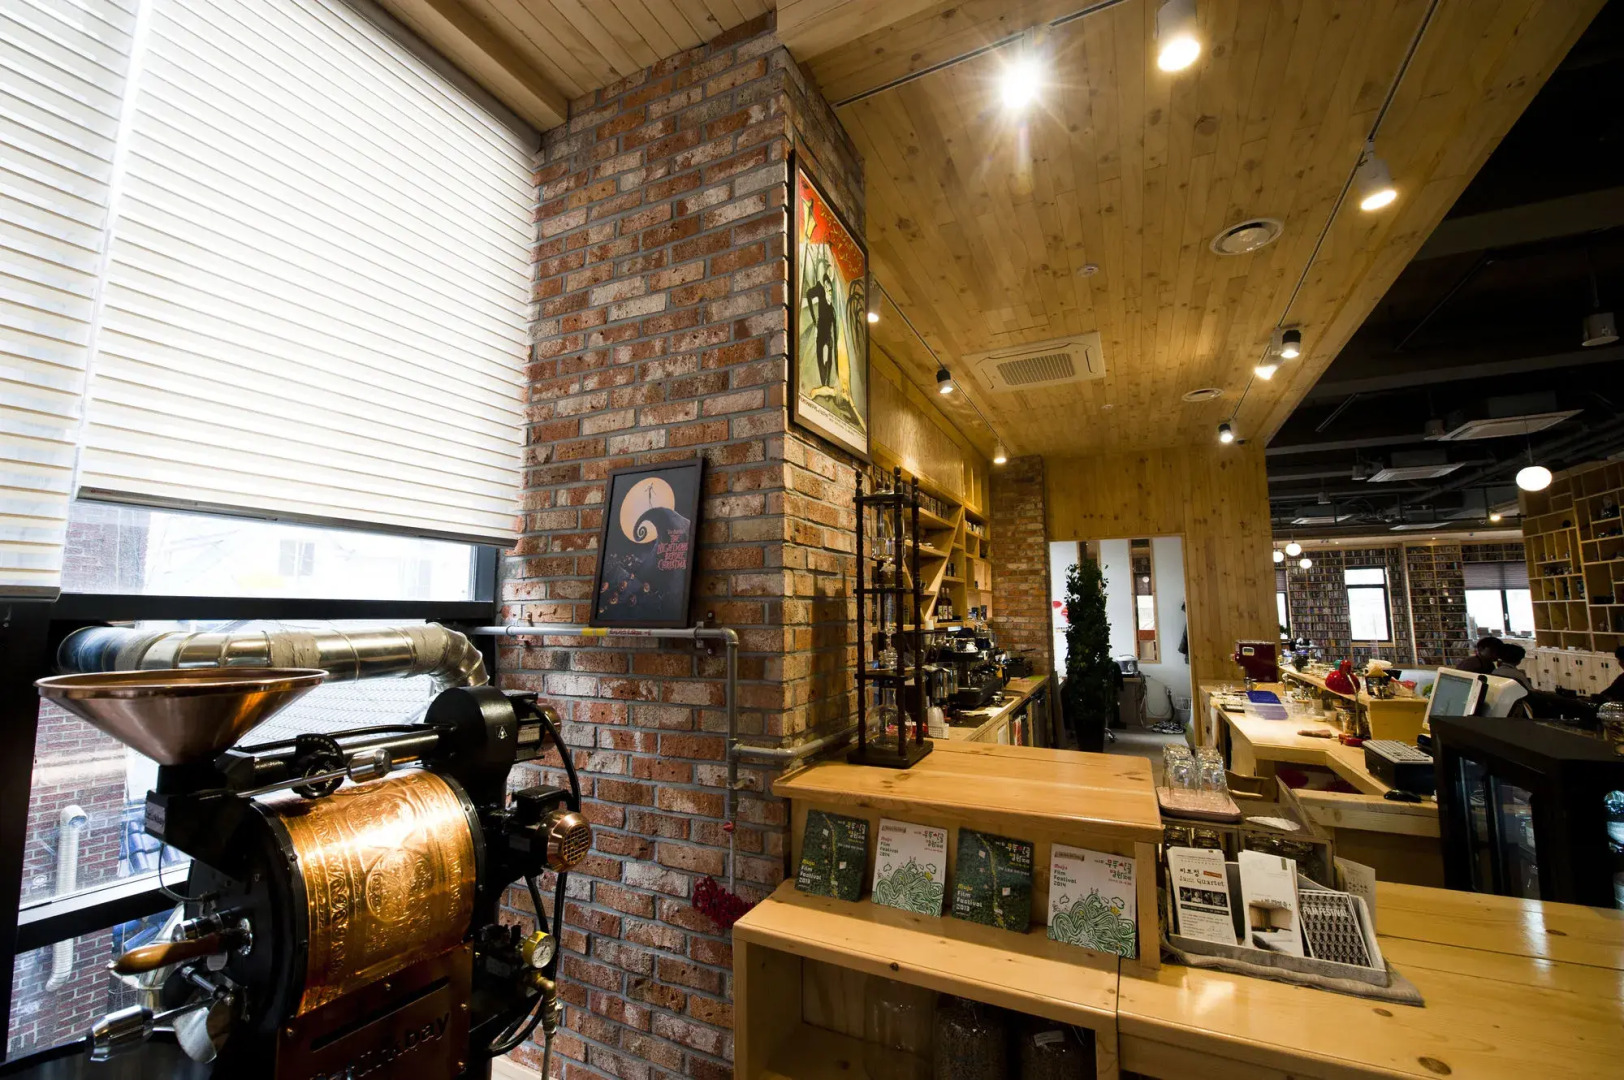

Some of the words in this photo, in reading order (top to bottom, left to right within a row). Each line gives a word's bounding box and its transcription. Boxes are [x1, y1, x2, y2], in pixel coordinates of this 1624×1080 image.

[800, 871, 822, 880] Festival
[1054, 875, 1077, 884] Festival
[1197, 878, 1225, 887] Quartet
[957, 890, 971, 898] Film
[956, 897, 983, 908] Festival
[956, 904, 970, 912] 2013
[1302, 906, 1320, 915] FILM
[1319, 907, 1349, 918] FESTIVAL
